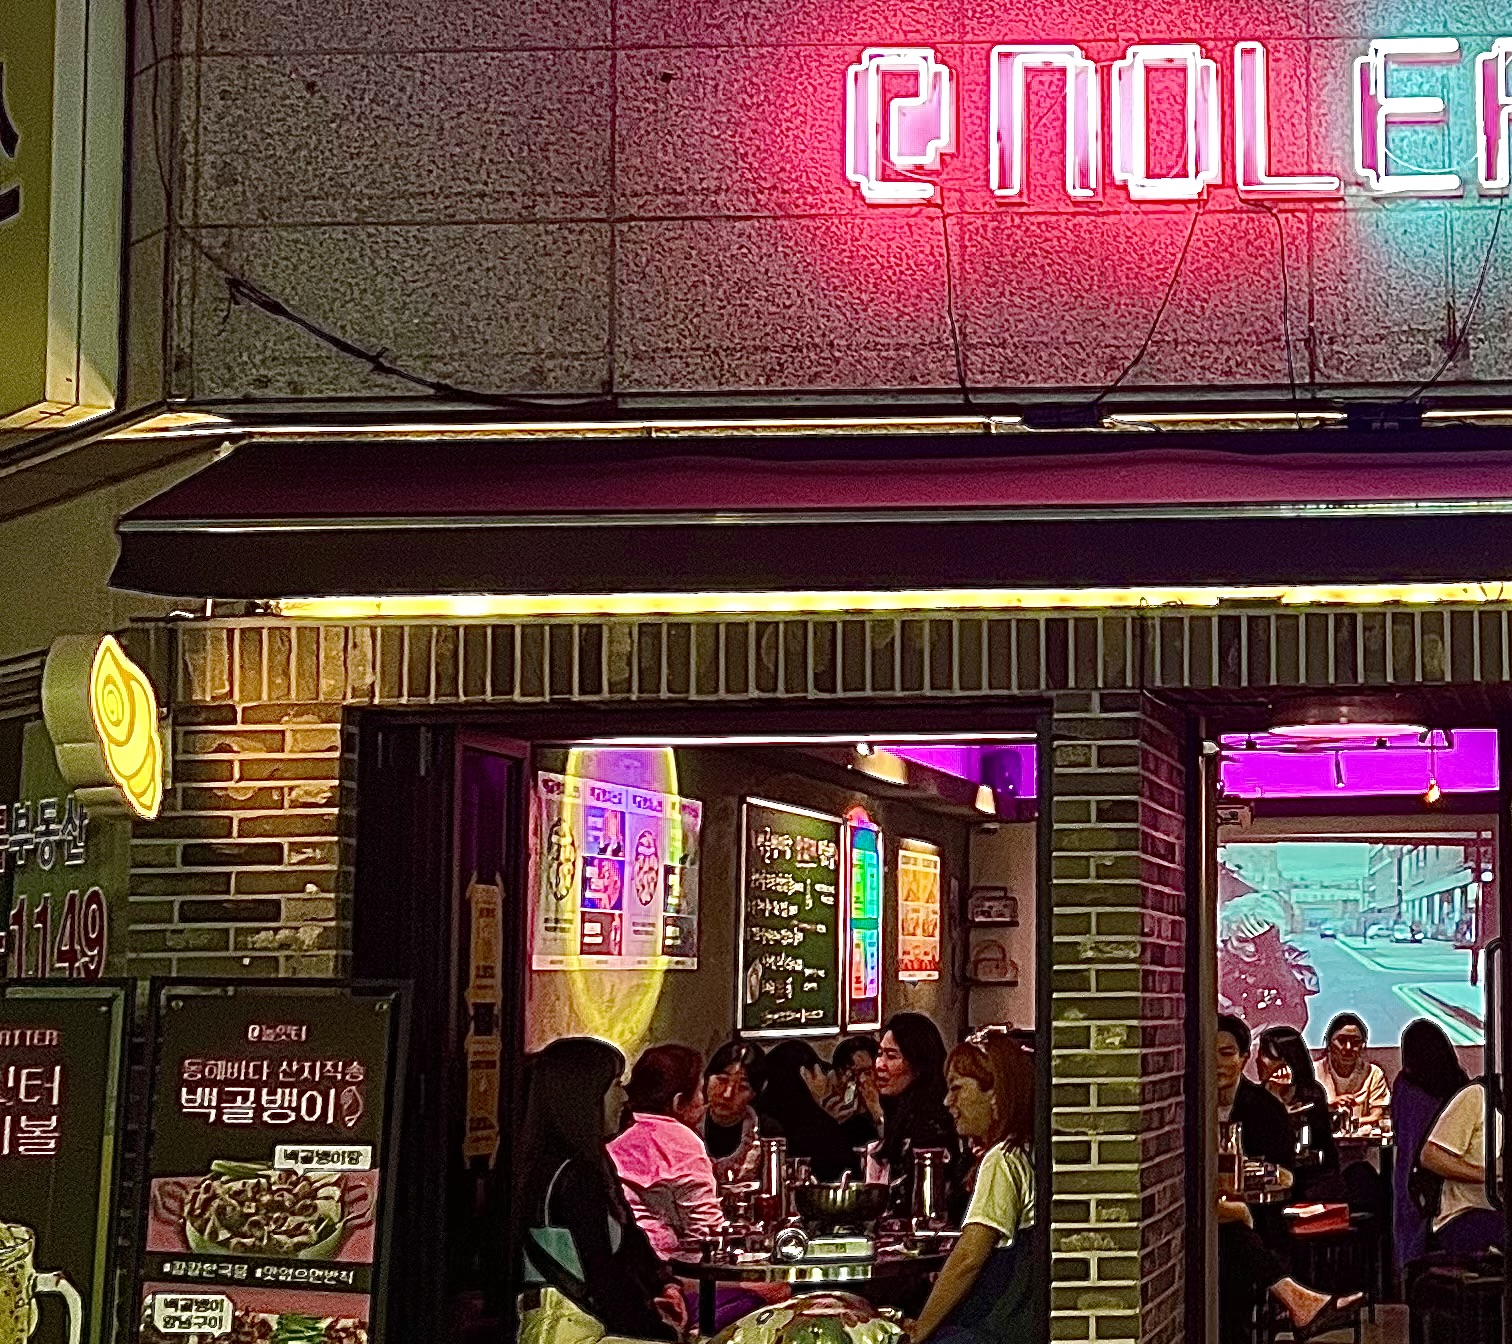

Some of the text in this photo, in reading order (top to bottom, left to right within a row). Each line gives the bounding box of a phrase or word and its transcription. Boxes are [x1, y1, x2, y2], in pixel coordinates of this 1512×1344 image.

[181, 1058, 366, 1082] 동해바다 산지직송
[180, 1087, 336, 1125] 백골뱅이
